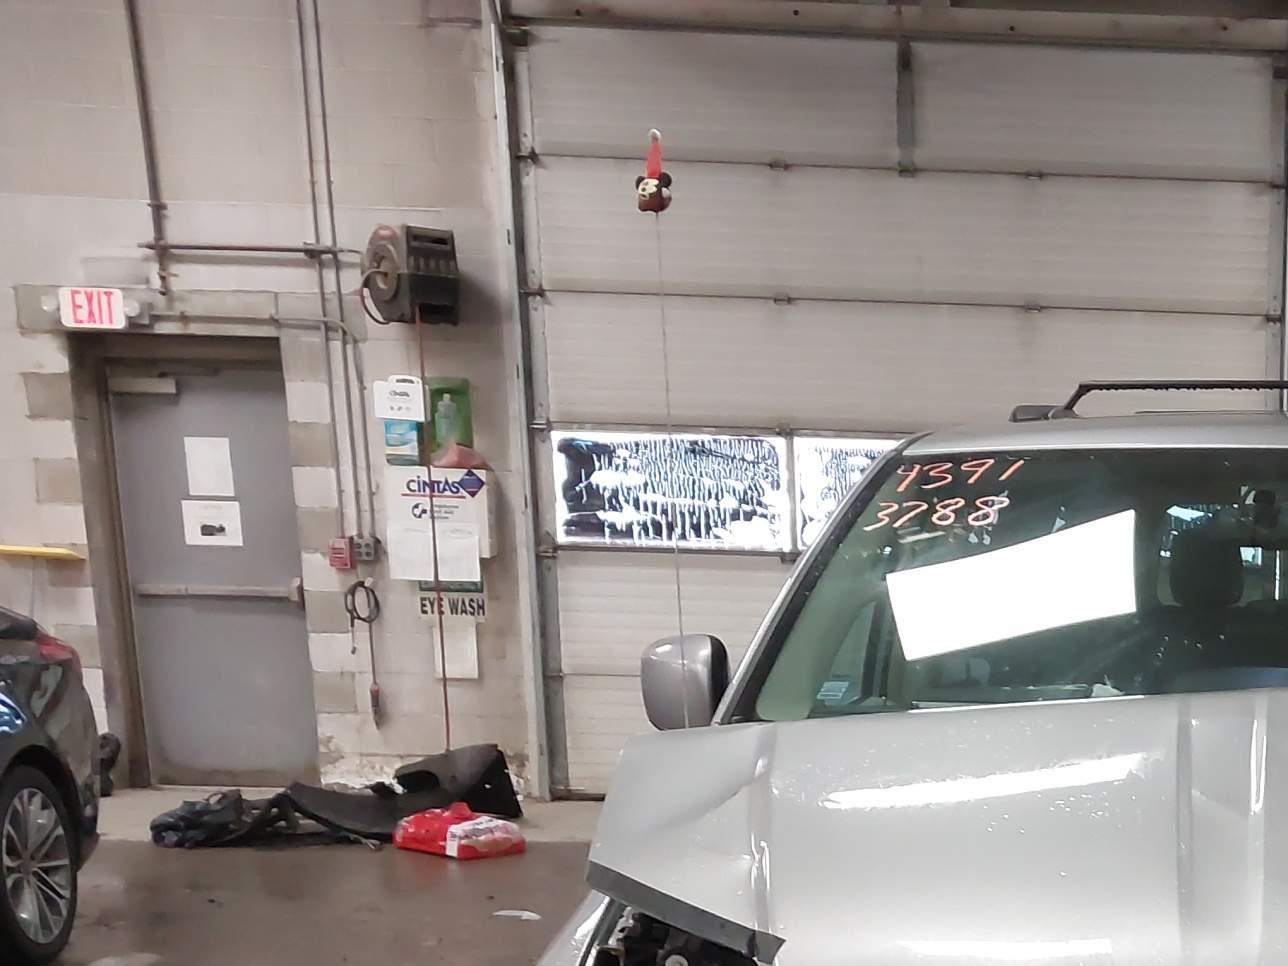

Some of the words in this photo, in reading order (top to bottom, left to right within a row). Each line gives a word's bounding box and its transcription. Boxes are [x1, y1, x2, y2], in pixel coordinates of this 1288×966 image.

[71, 289, 114, 324] EXIT
[896, 457, 1025, 492] 4391
[862, 496, 1011, 532] 3788
[448, 596, 486, 617] WASH
